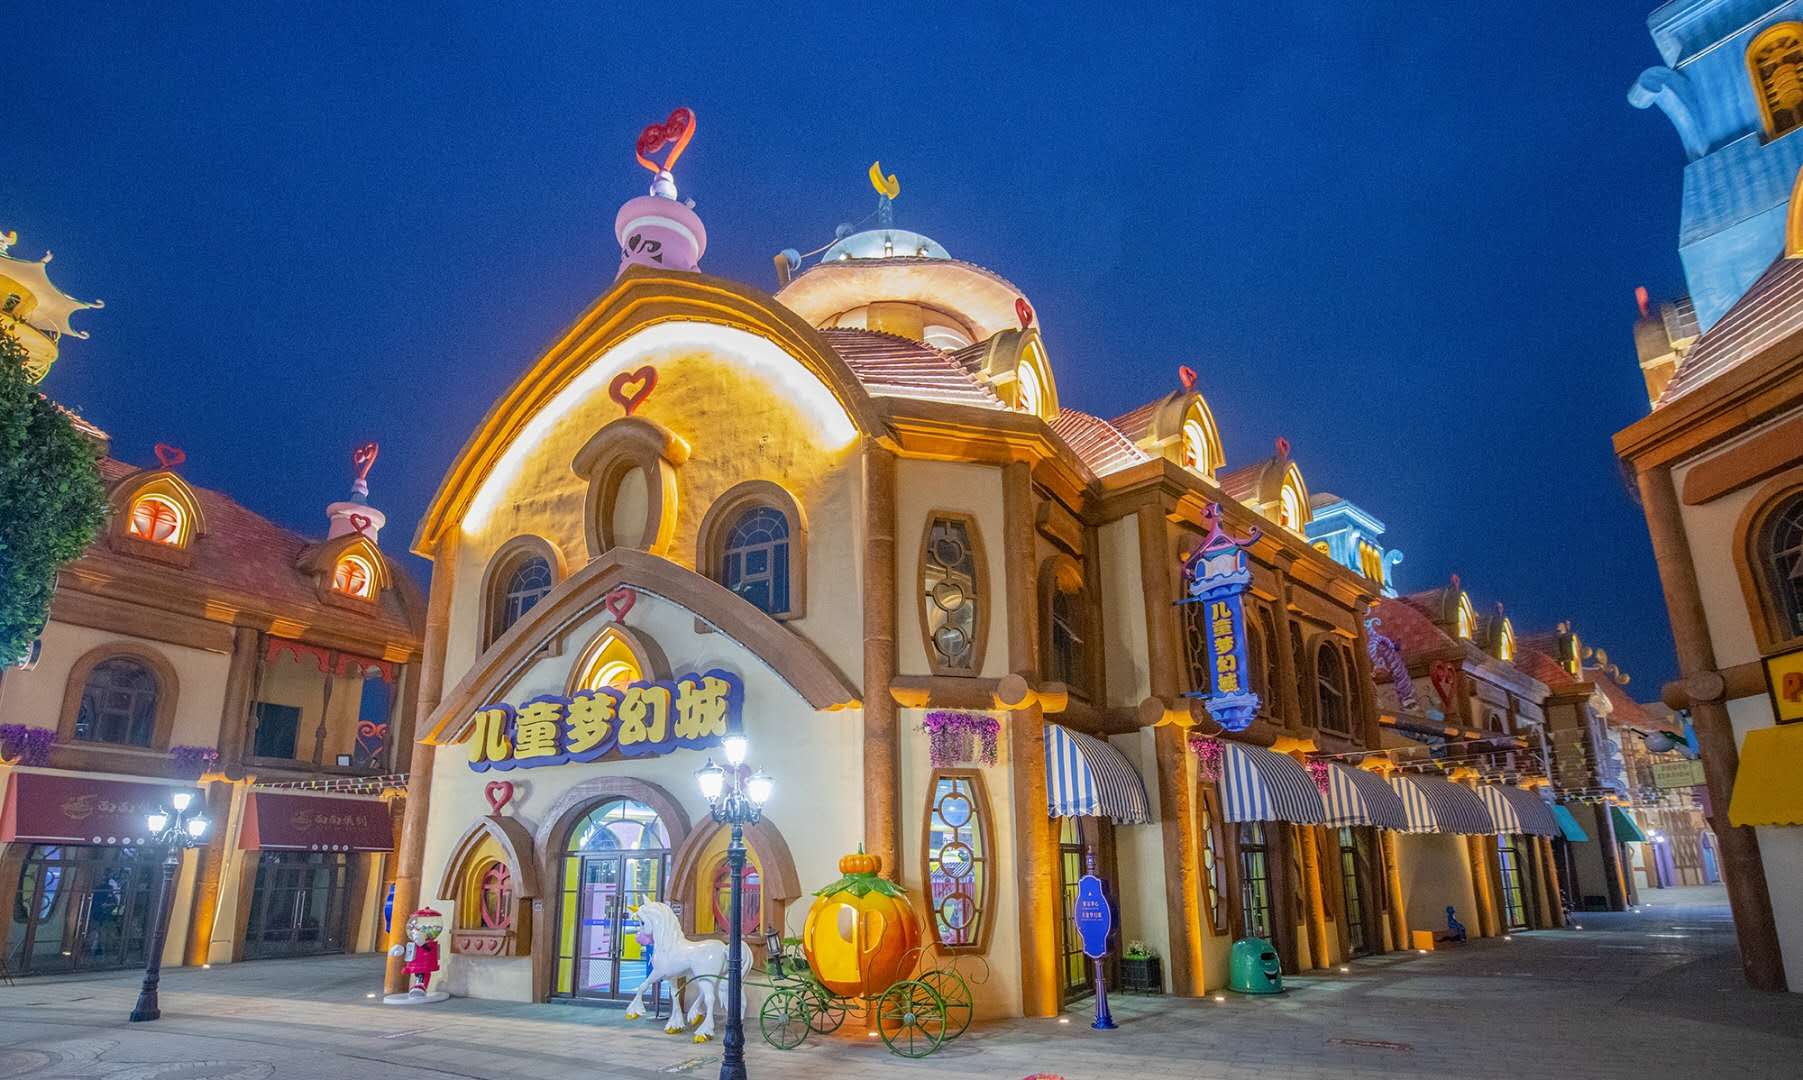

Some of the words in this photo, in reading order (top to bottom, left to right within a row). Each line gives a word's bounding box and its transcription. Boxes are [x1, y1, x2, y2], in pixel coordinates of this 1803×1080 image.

[1211, 602, 1239, 693] 儿童梦幻城
[469, 676, 730, 762] 儿童梦幻城
